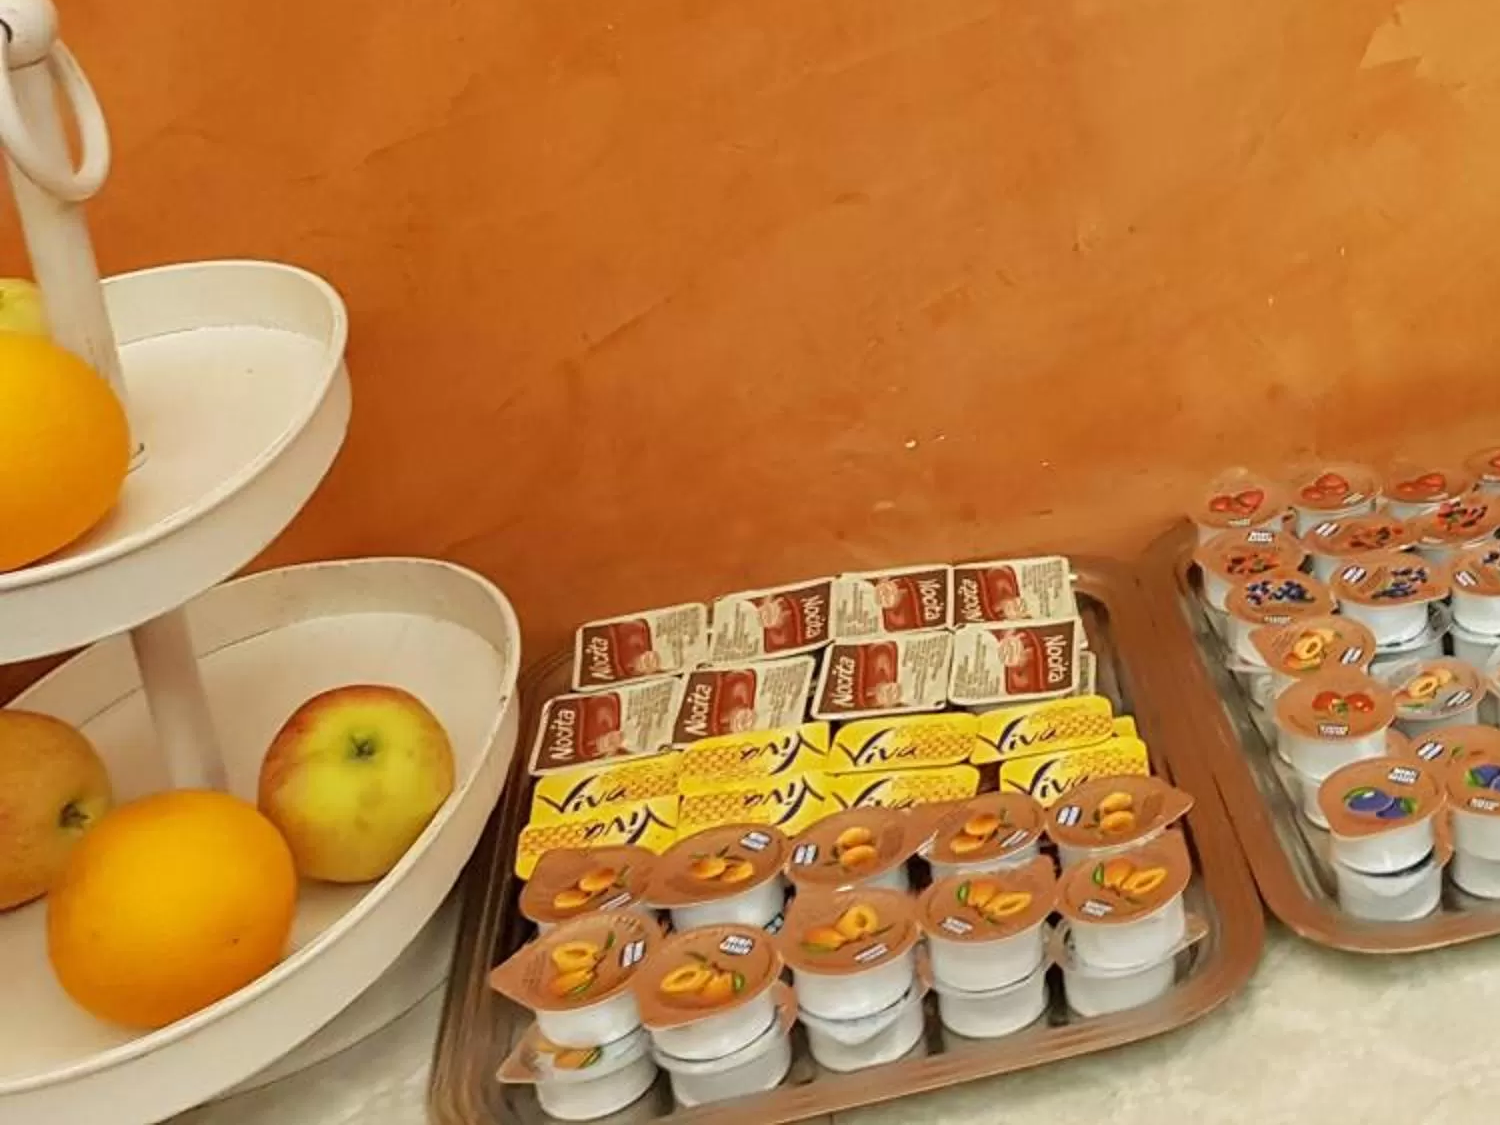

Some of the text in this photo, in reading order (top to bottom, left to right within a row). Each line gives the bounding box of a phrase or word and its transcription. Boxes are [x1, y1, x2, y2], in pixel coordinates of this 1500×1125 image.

[830, 655, 856, 709] Nocita
[1043, 633, 1068, 684] Nocita
[548, 708, 577, 762] Nocita
[683, 683, 713, 737] Nocita
[976, 713, 1058, 753] Viva
[836, 725, 917, 767] Viva
[537, 773, 629, 814] Viva
